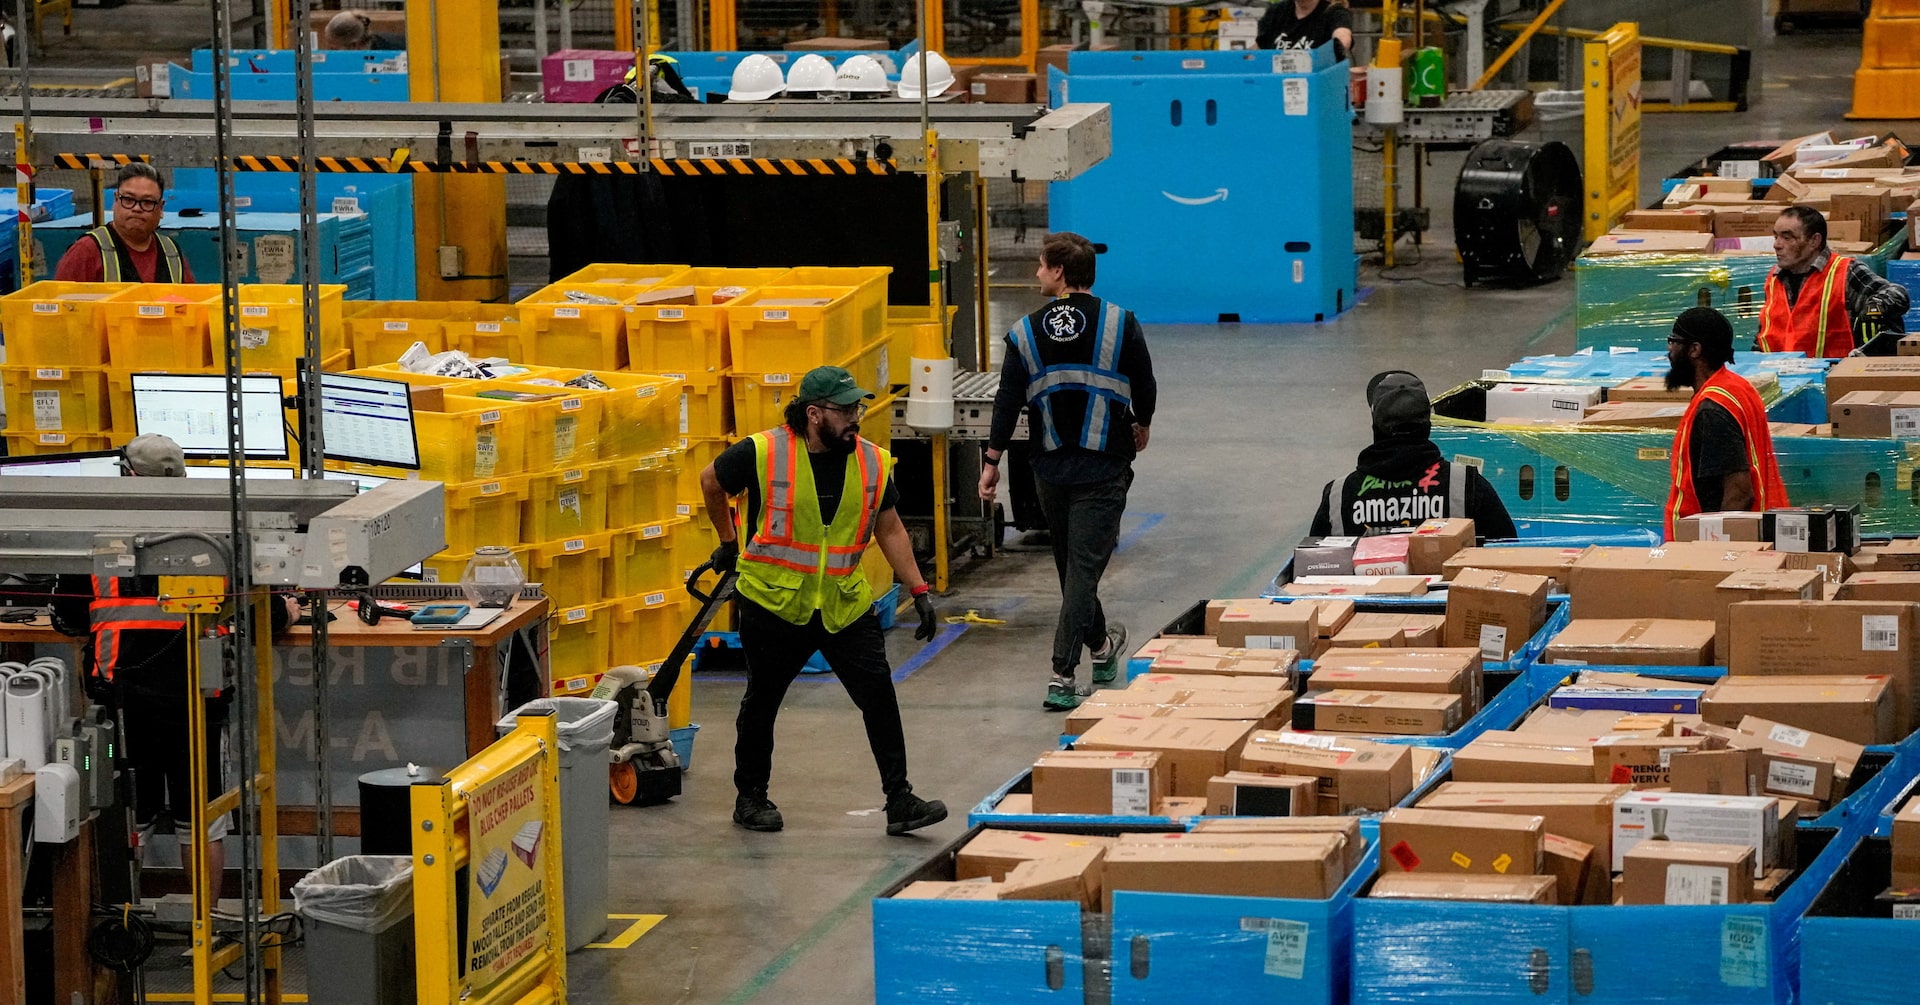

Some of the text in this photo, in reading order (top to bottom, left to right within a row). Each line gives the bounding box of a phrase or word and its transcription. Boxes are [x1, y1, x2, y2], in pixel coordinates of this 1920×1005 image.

[1049, 332, 1080, 342] LEADERSHIP
[1352, 487, 1444, 525] amazing
[473, 796, 481, 816] DO
[482, 786, 496, 809] NOT
[497, 773, 518, 799] RE-USE
[480, 785, 535, 837] BLUE CHEP PALLETS
[473, 931, 492, 954] WOOD
[492, 916, 514, 940] PALLETS
[514, 909, 525, 928] AND
[525, 899, 537, 919] SEND
[482, 879, 542, 934] SEPARATE FROM REGULAR
[471, 908, 547, 972] REMOVAL FROM THE BUILDING
